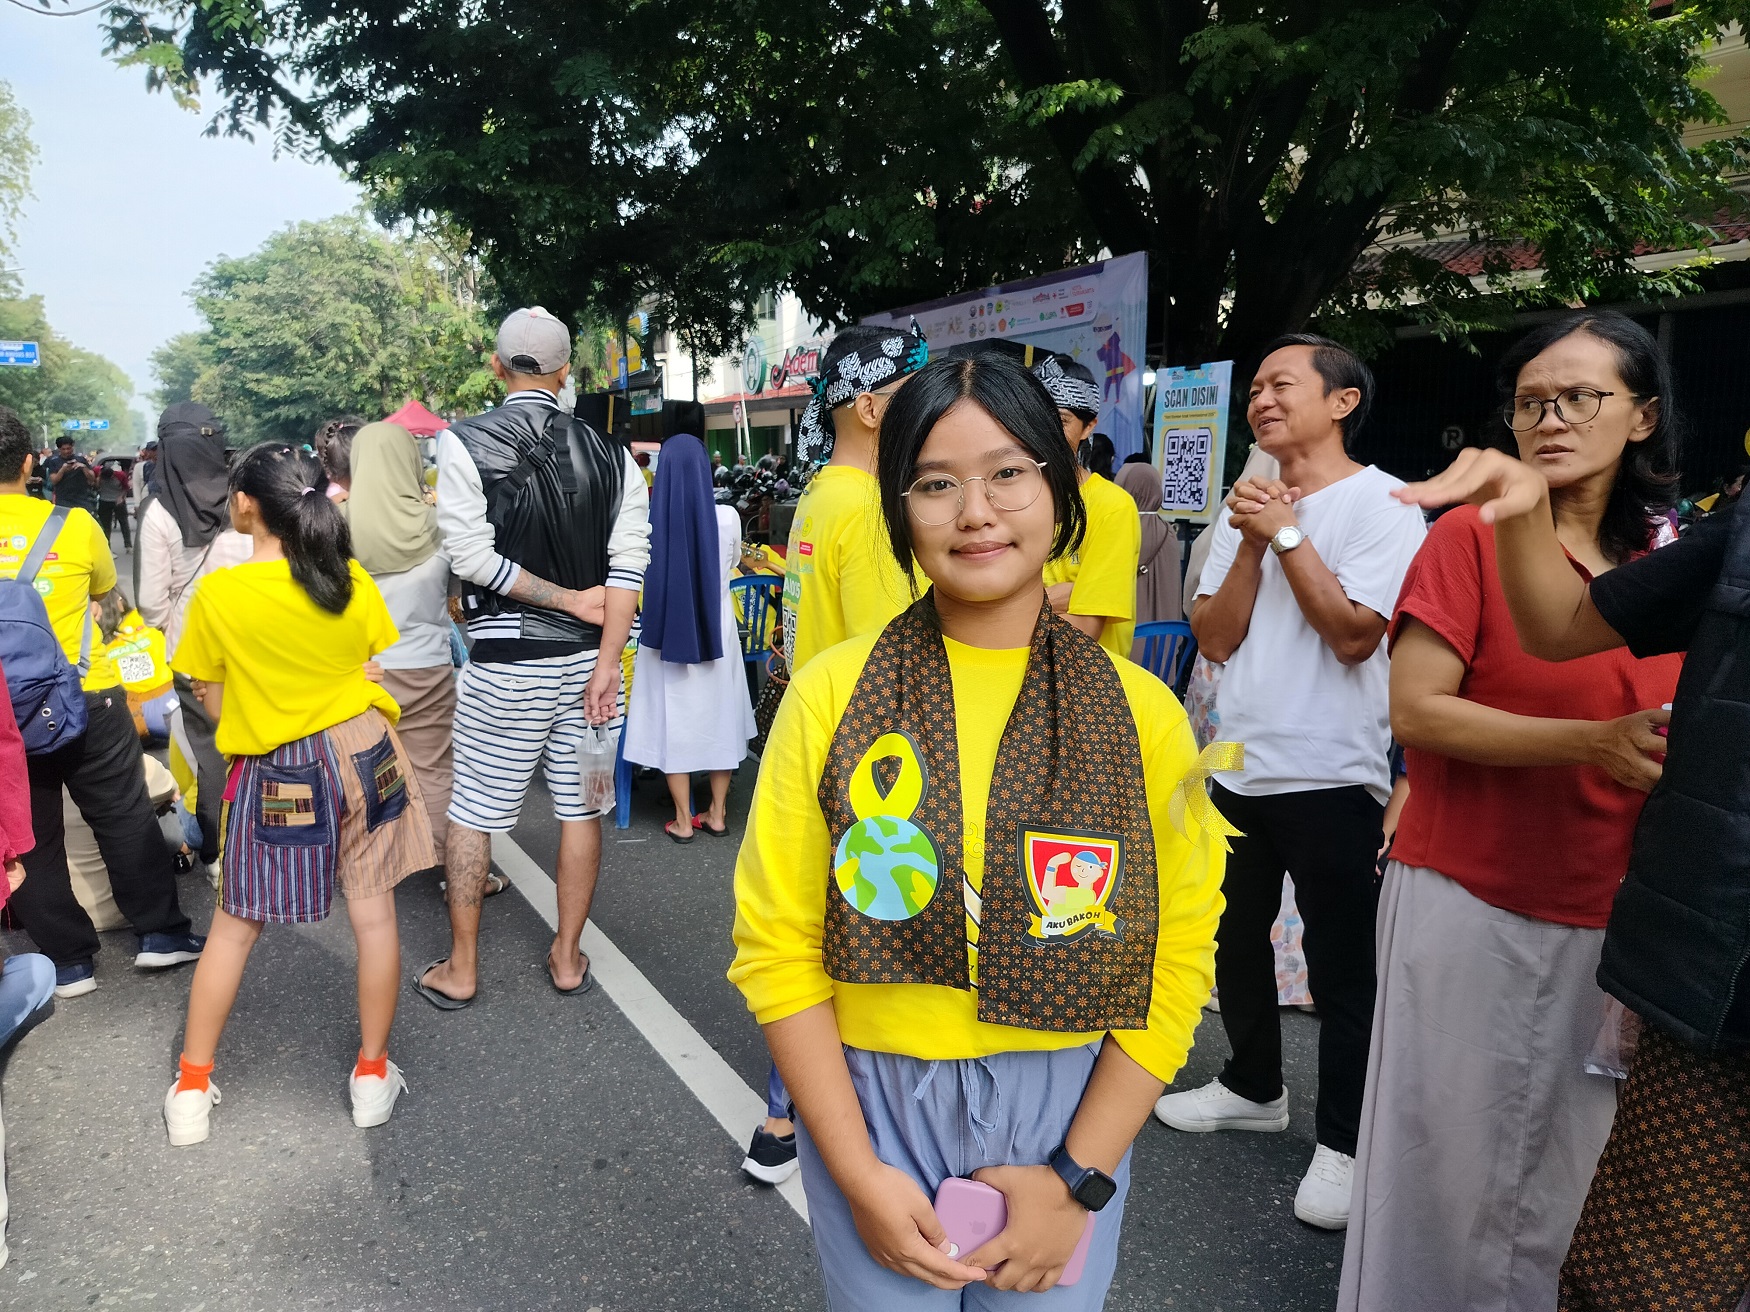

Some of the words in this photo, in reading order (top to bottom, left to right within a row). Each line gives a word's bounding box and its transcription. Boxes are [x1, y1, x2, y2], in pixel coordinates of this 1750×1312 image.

[1164, 387, 1189, 409] SCAN
[1191, 385, 1219, 407] DISINI
[1045, 921, 1066, 929] AKU
[1066, 911, 1101, 926] BAKOH
